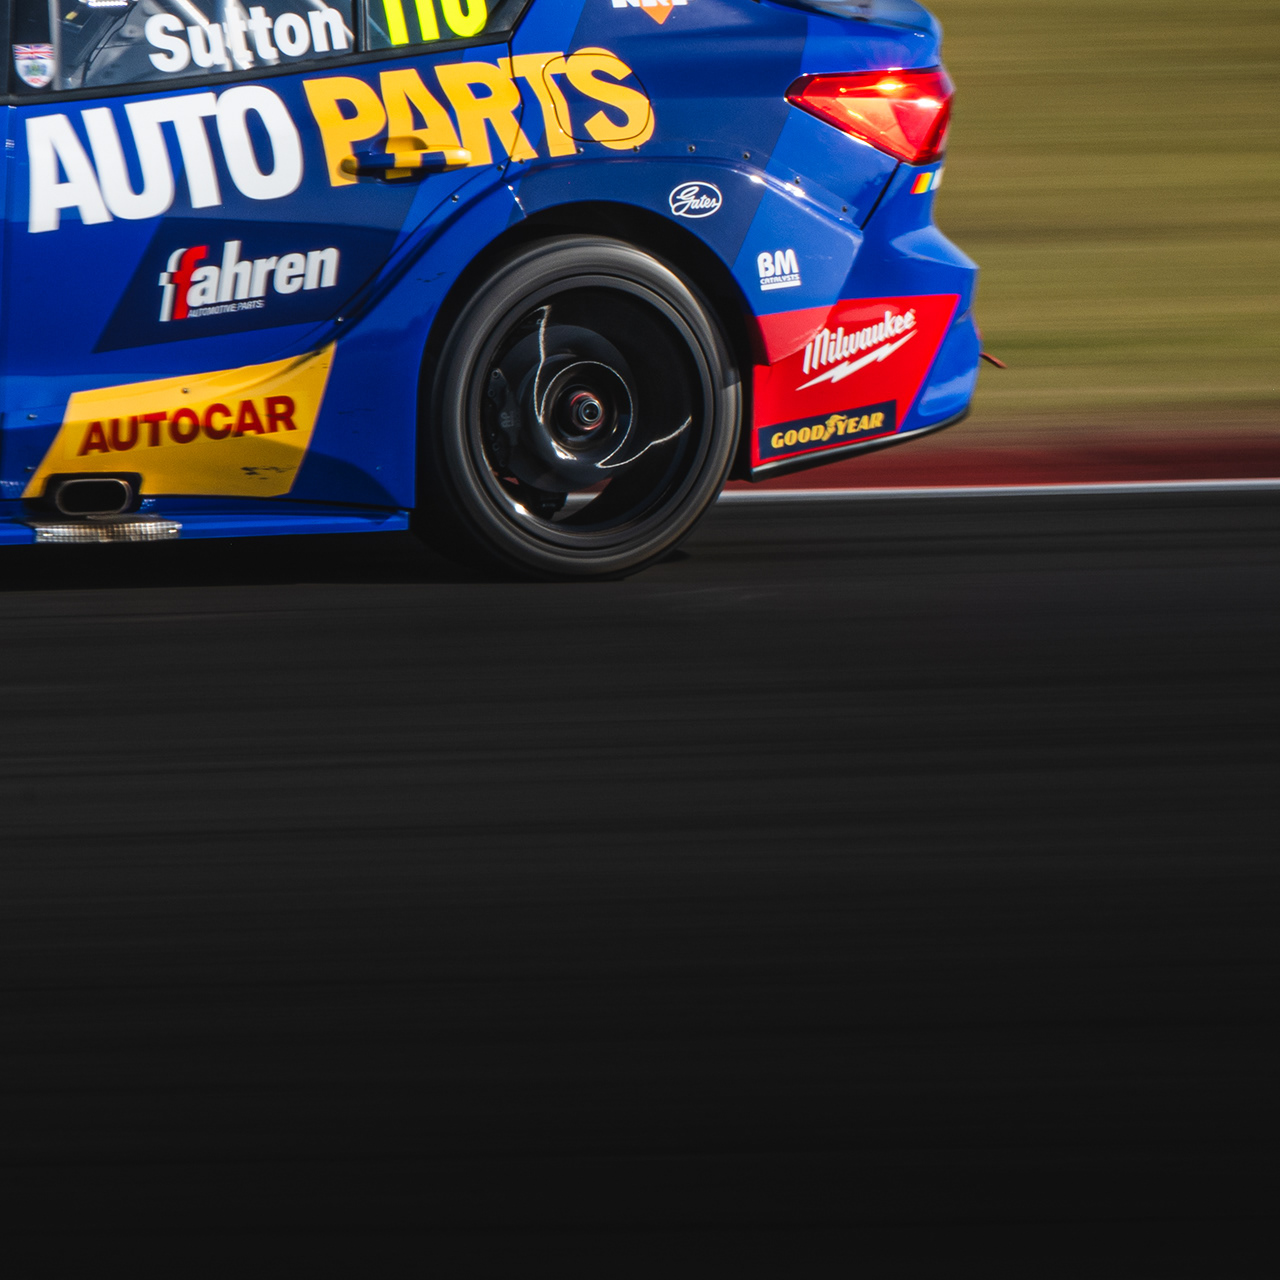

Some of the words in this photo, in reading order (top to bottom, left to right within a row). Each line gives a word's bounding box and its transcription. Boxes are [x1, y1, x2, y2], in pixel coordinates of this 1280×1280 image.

[145, 5, 348, 72] Sutton
[26, 85, 305, 233] AUTO
[302, 47, 654, 187] PARTS
[672, 186, 718, 215] Gates
[158, 240, 340, 322] fahren
[757, 249, 799, 278] BM
[760, 274, 800, 285] CATALYSTS
[187, 303, 238, 318] AUTOMOTIVE
[238, 300, 265, 312] PARTS
[802, 310, 917, 374] Milwaukee
[77, 395, 298, 456] AUTOCAR
[771, 412, 885, 449] GOODYEAR
